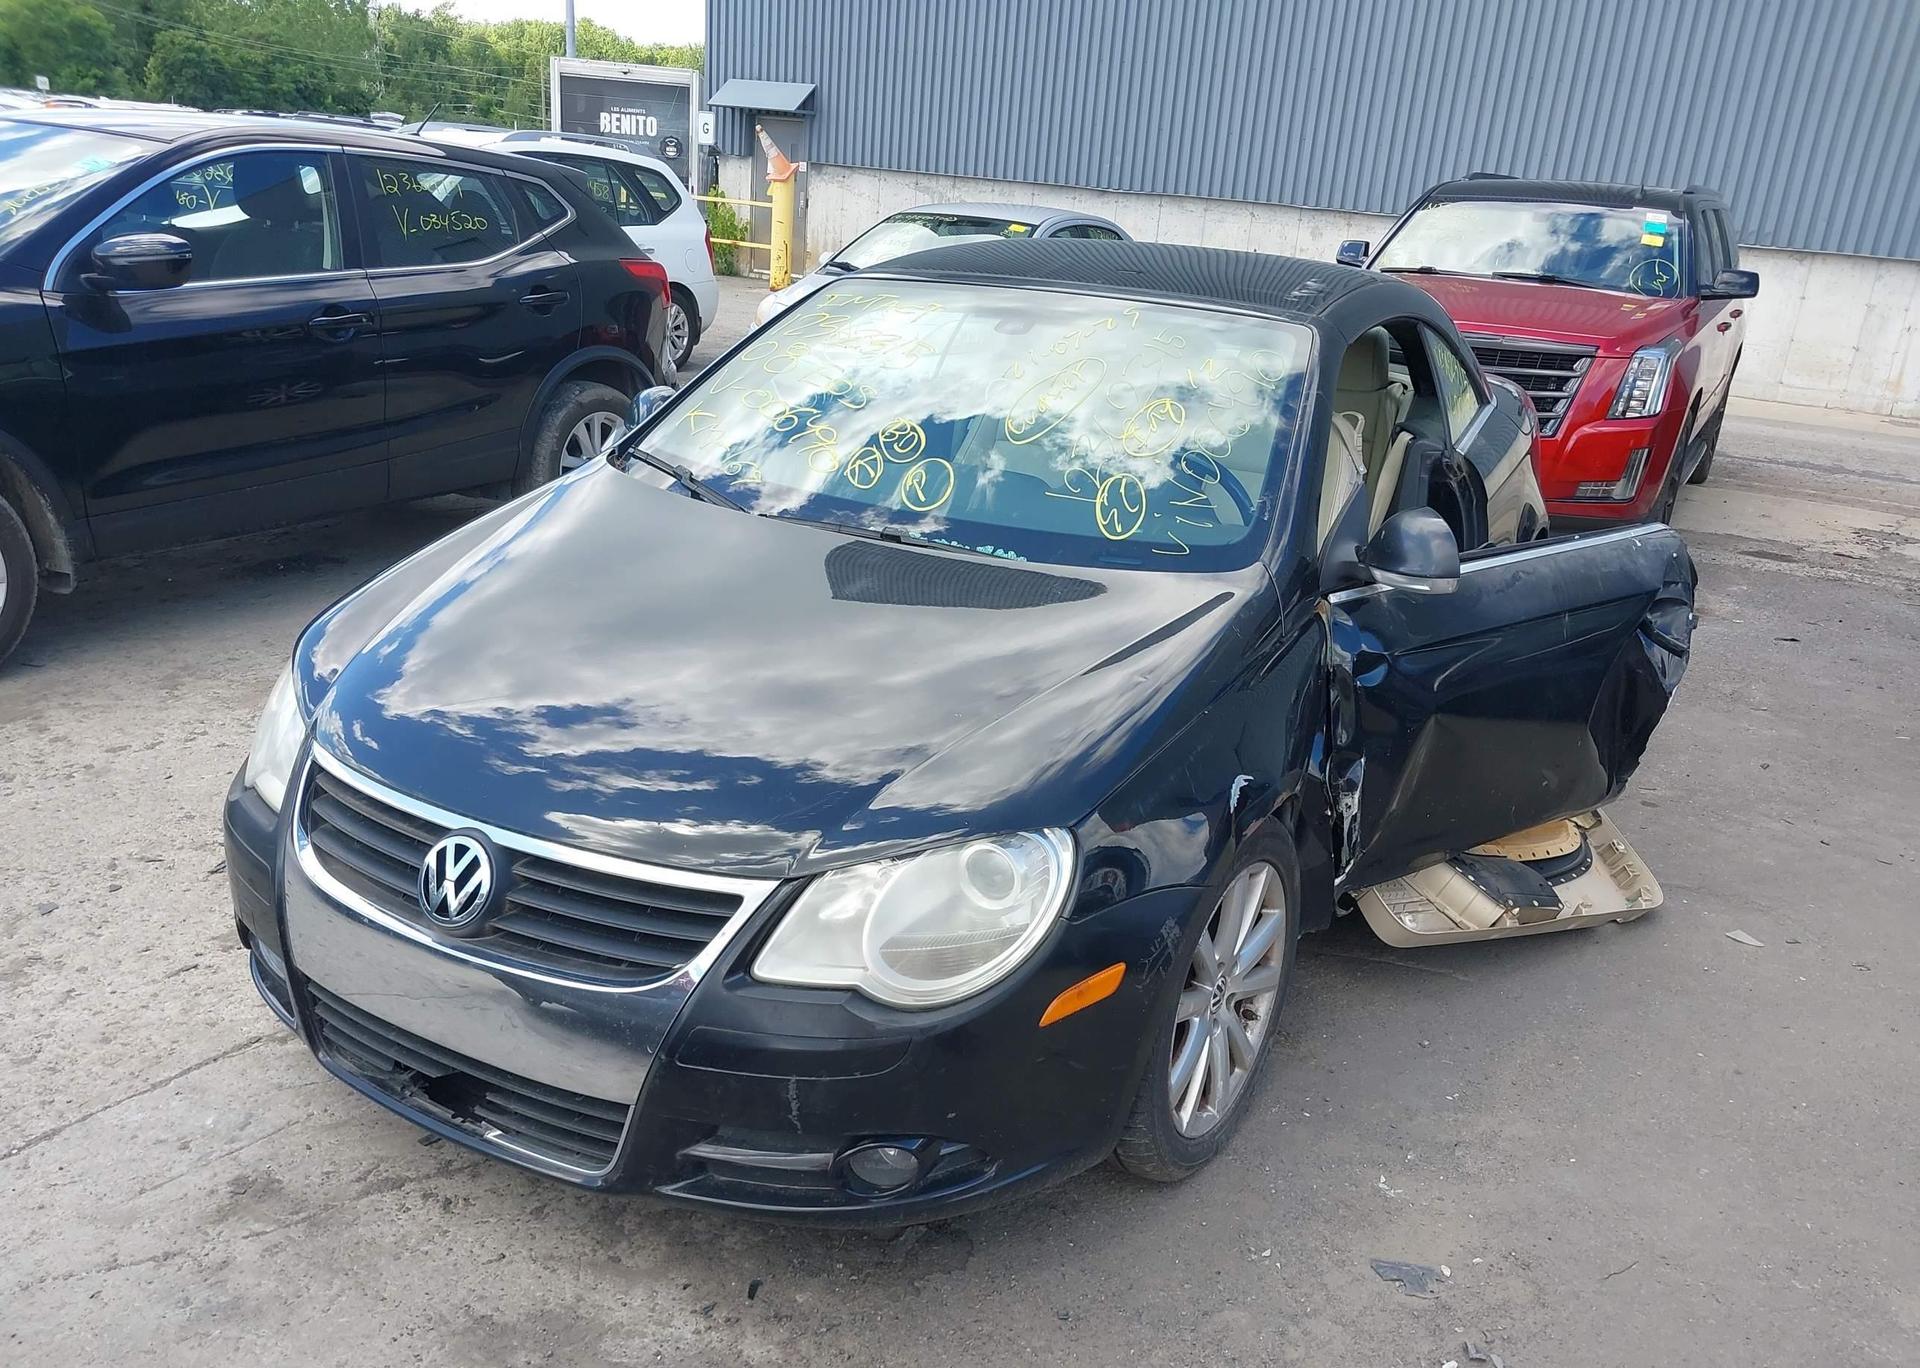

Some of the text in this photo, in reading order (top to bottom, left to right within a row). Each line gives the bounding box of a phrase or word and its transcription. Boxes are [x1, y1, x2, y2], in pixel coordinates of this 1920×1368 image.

[600, 112, 657, 137] BENITO
[702, 123, 709, 134] G
[421, 835, 491, 926] VW
